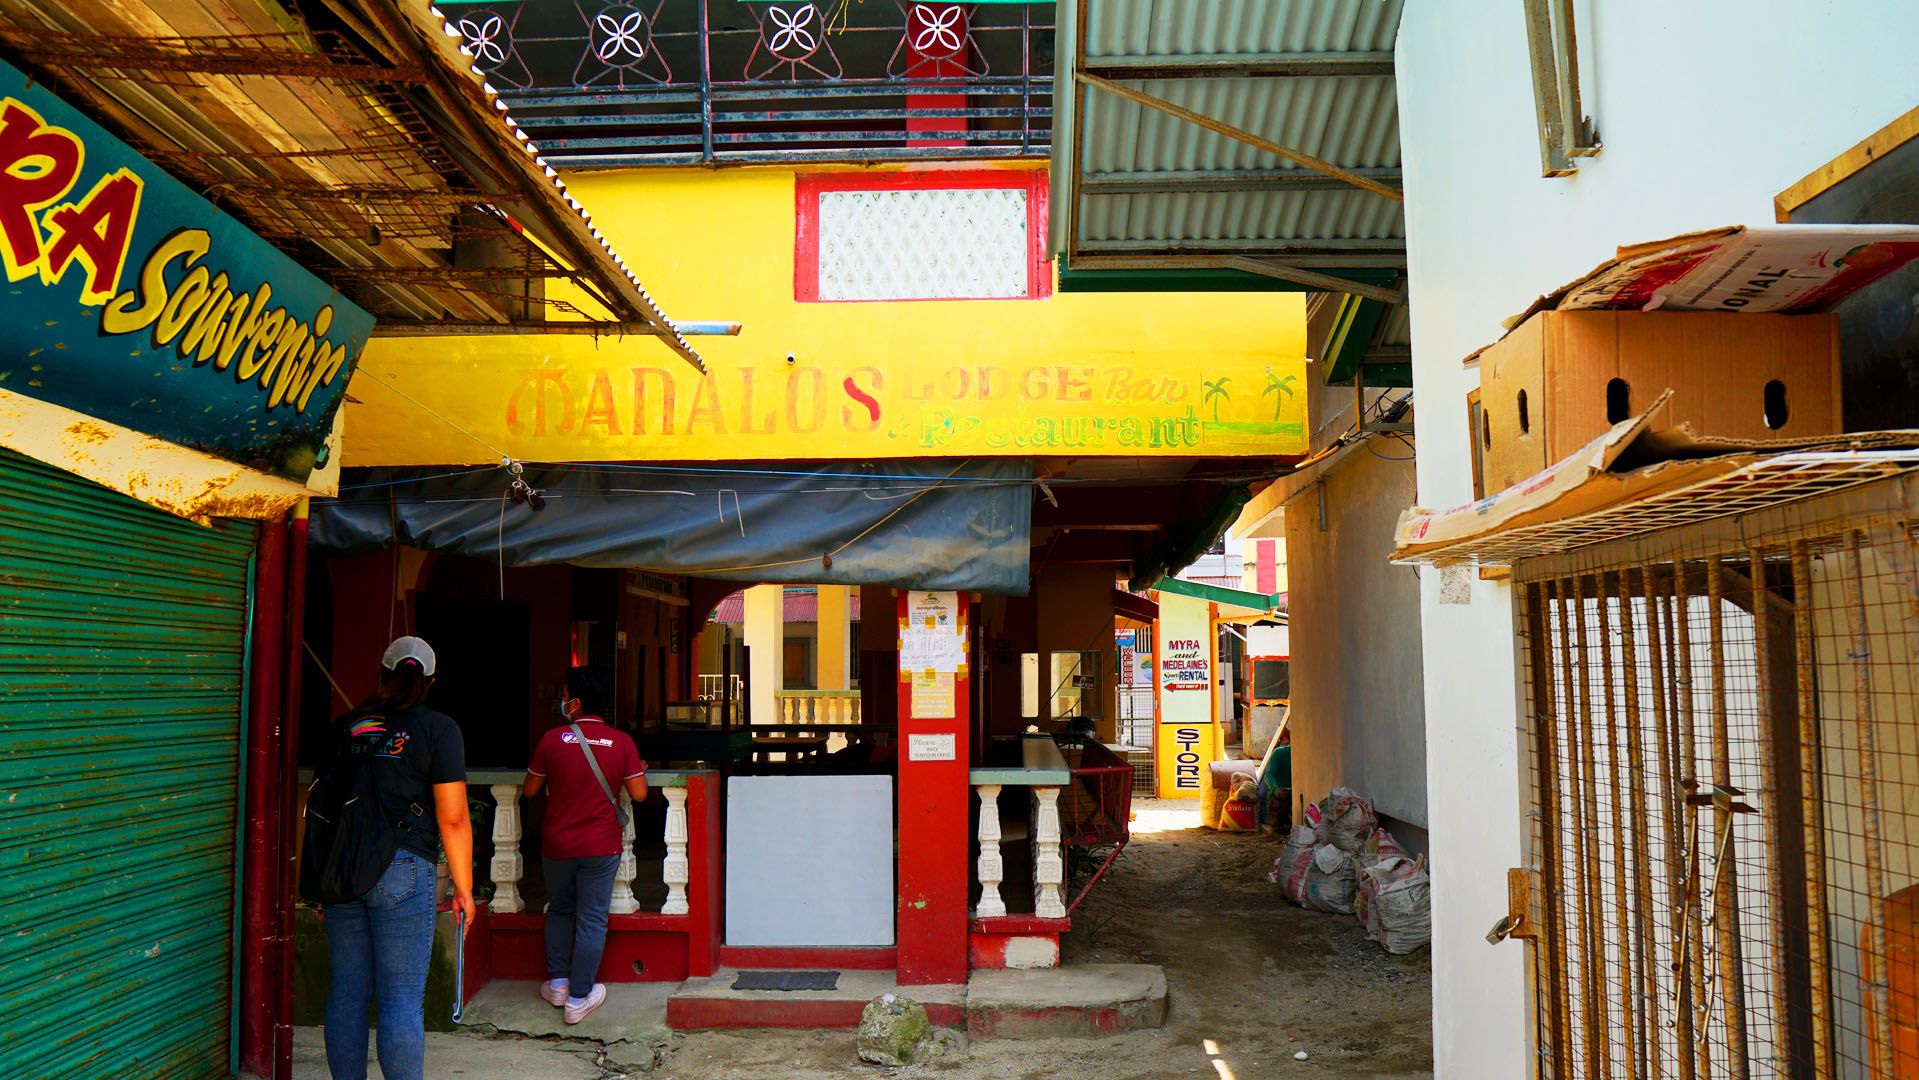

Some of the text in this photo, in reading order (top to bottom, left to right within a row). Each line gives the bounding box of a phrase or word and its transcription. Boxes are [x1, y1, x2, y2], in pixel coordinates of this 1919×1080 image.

[101, 227, 347, 413] Souvenir
[506, 366, 883, 437] MANALOS
[903, 366, 1189, 406] LODGE Bar
[919, 403, 1201, 449] Restaurant
[1169, 639, 1200, 650] MYRA
[1171, 651, 1199, 659] and
[1179, 671, 1208, 680] RENTAL
[1177, 728, 1200, 789] STORE
